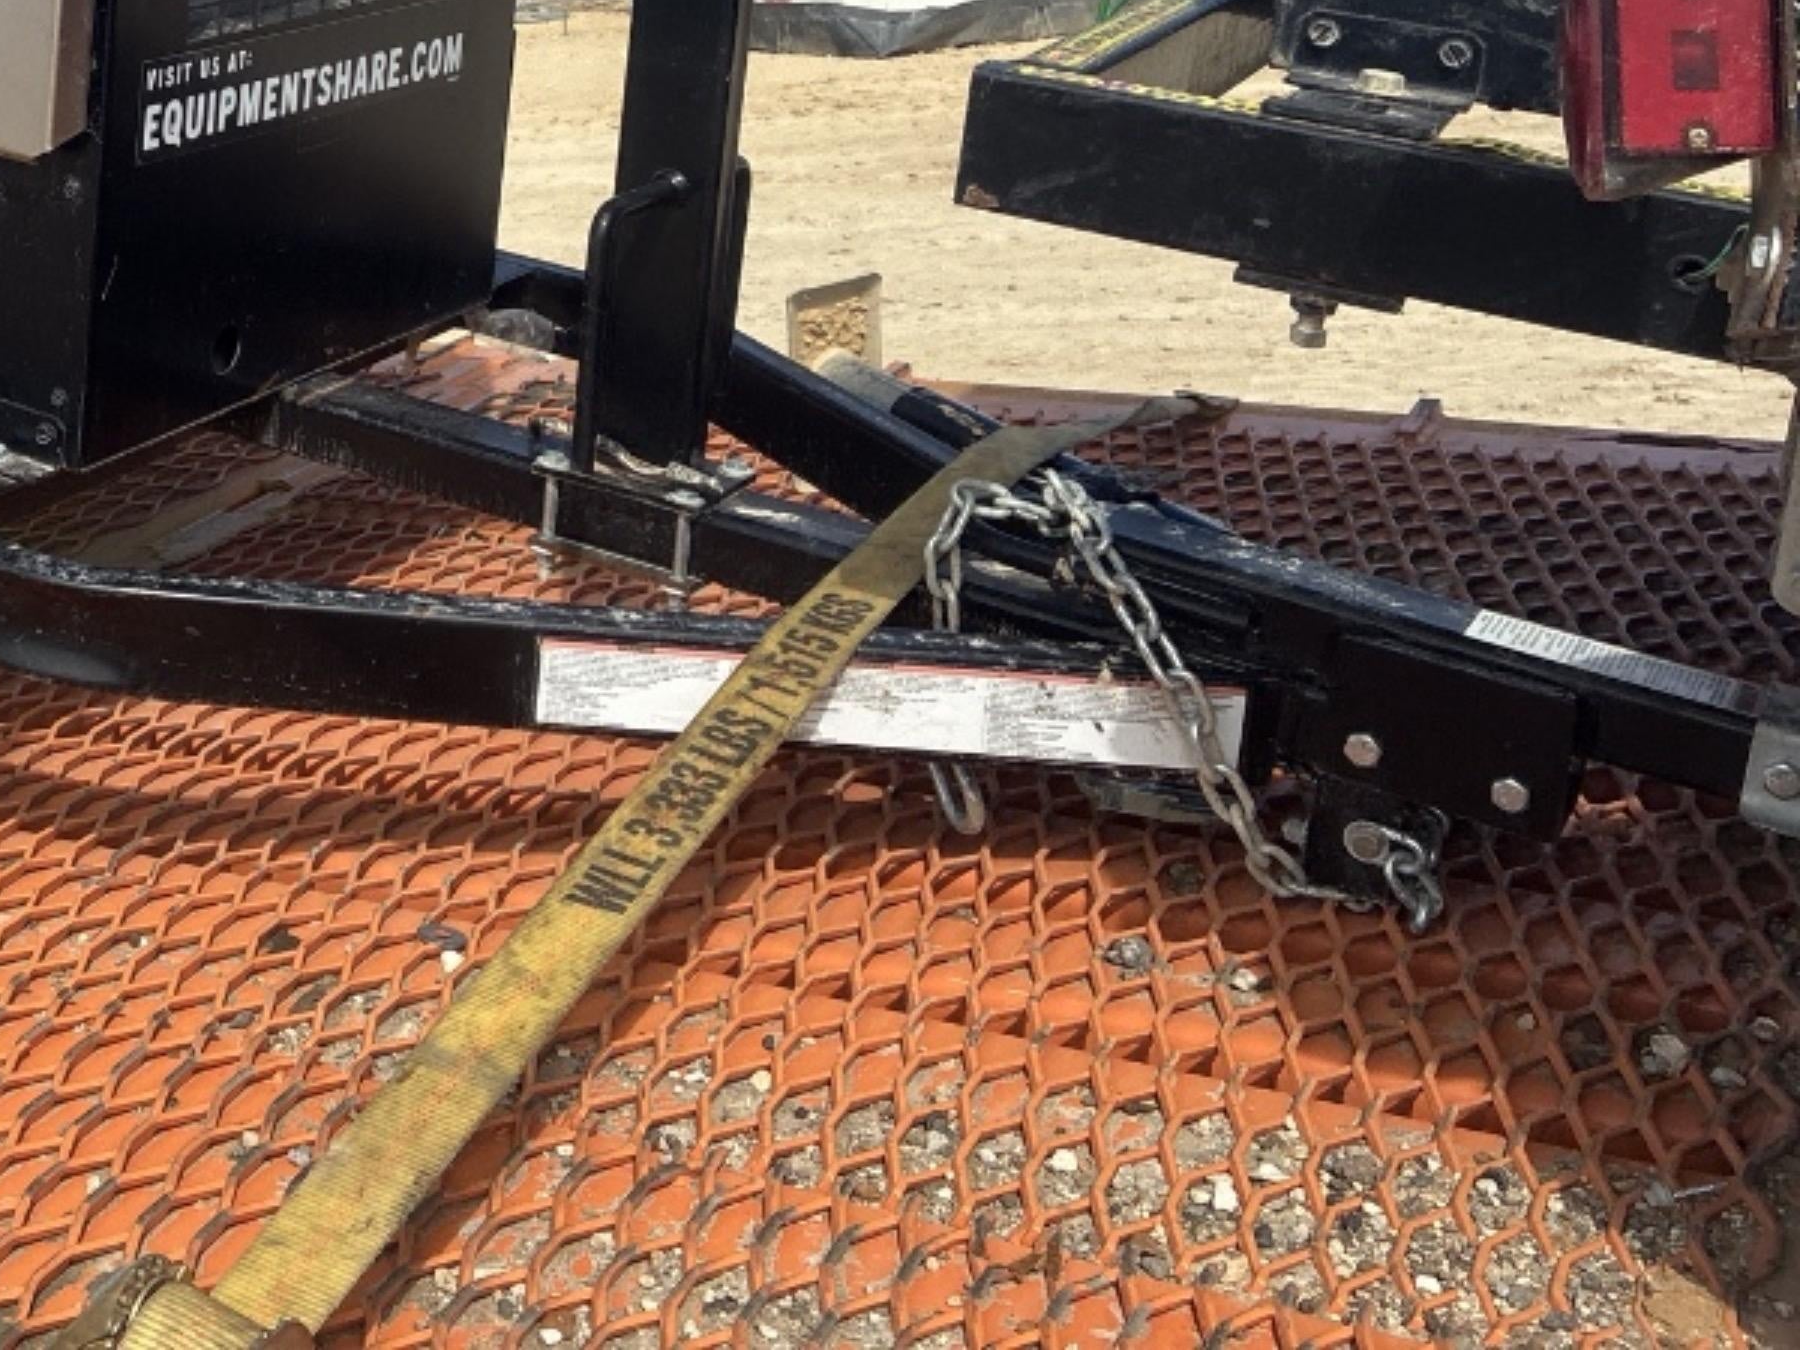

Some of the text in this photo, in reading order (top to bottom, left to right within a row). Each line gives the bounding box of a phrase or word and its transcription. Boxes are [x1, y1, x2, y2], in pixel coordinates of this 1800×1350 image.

[143, 33, 463, 151] EQUIPMENTSHARE.COM
[146, 50, 253, 90] VISIT US AT:
[562, 848, 666, 915] WLL
[687, 707, 773, 770] LBS
[802, 592, 875, 636] KGS
